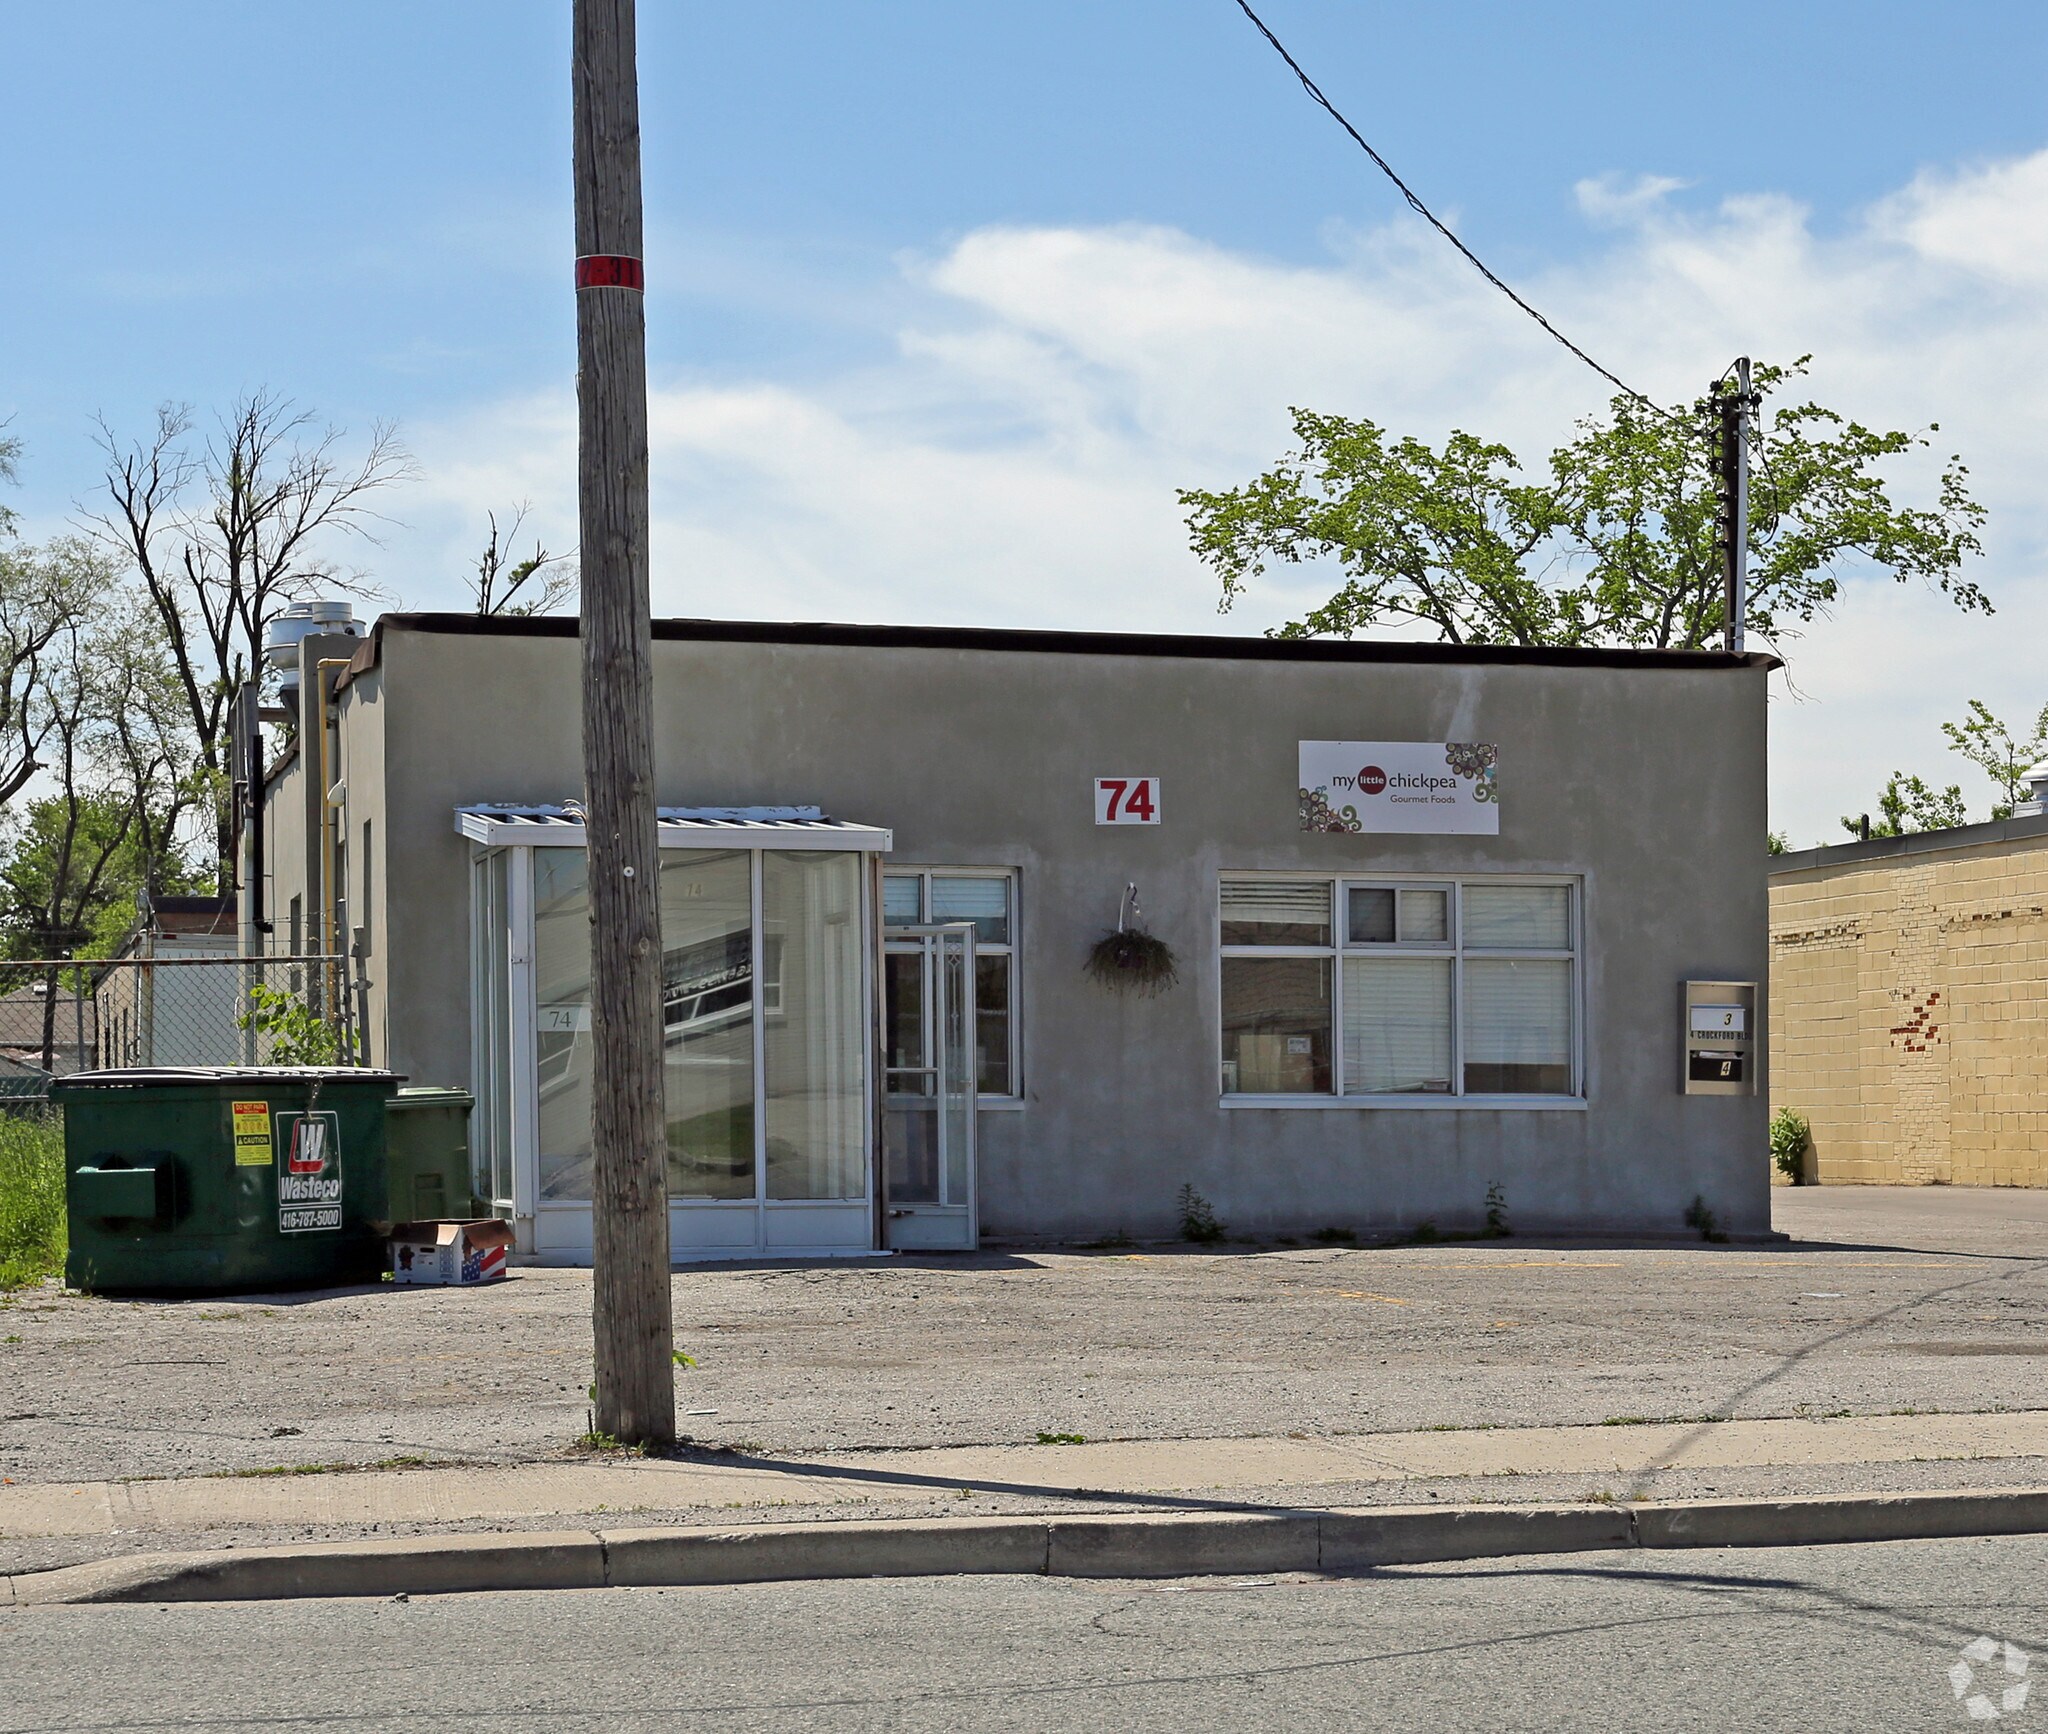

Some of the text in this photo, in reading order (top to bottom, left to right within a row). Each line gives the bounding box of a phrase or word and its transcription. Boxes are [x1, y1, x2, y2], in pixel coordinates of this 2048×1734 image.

[1332, 773, 1457, 792] my little chickpea
[1100, 780, 1155, 821] 74
[1390, 795, 1456, 804] Gourmet Foods
[549, 1011, 572, 1028] 74
[1724, 1013, 1732, 1026] 3
[1697, 1030, 1735, 1040] CROCKFORD
[1722, 1062, 1729, 1074] 4
[243, 1136, 269, 1144] CAUTION
[281, 1176, 339, 1200] Wasteco
[282, 1209, 339, 1229] 416-787-5000
